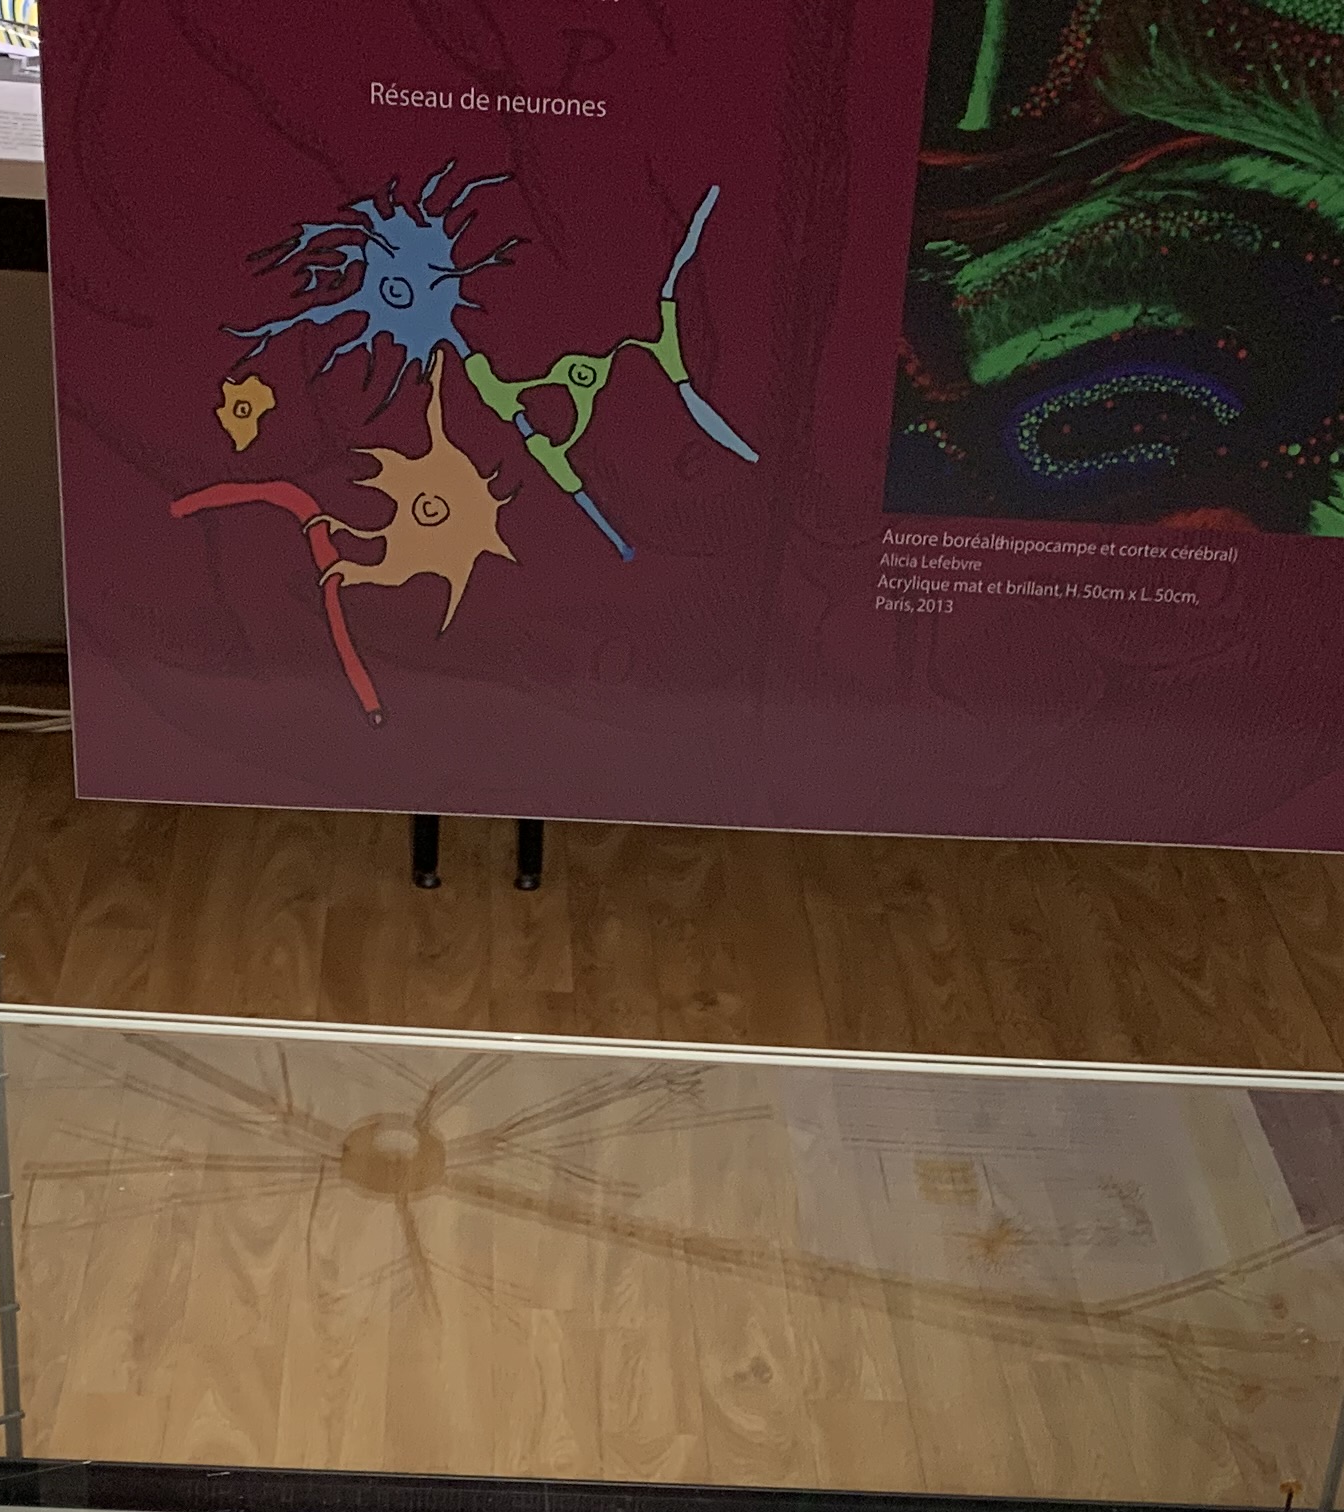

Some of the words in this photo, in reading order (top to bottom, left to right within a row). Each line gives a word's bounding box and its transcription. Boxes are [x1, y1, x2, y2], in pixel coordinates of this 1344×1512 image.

[370, 82, 452, 109] Réseau
[460, 88, 490, 111] de
[497, 94, 607, 117] neurones
[882, 528, 938, 546] Aurore
[1100, 543, 1115, 555] et
[1119, 545, 1167, 558] cortex
[1171, 546, 1238, 564] cérébral)
[880, 553, 917, 568] Alicia
[921, 555, 982, 571] Lefebvre
[877, 575, 949, 593] Acrylique
[954, 580, 982, 593] mat
[987, 583, 1002, 594] et
[1006, 580, 1063, 599] brillant,
[1128, 591, 1136, 600] x
[875, 596, 914, 612] Paris,
[917, 599, 953, 613] 2013
